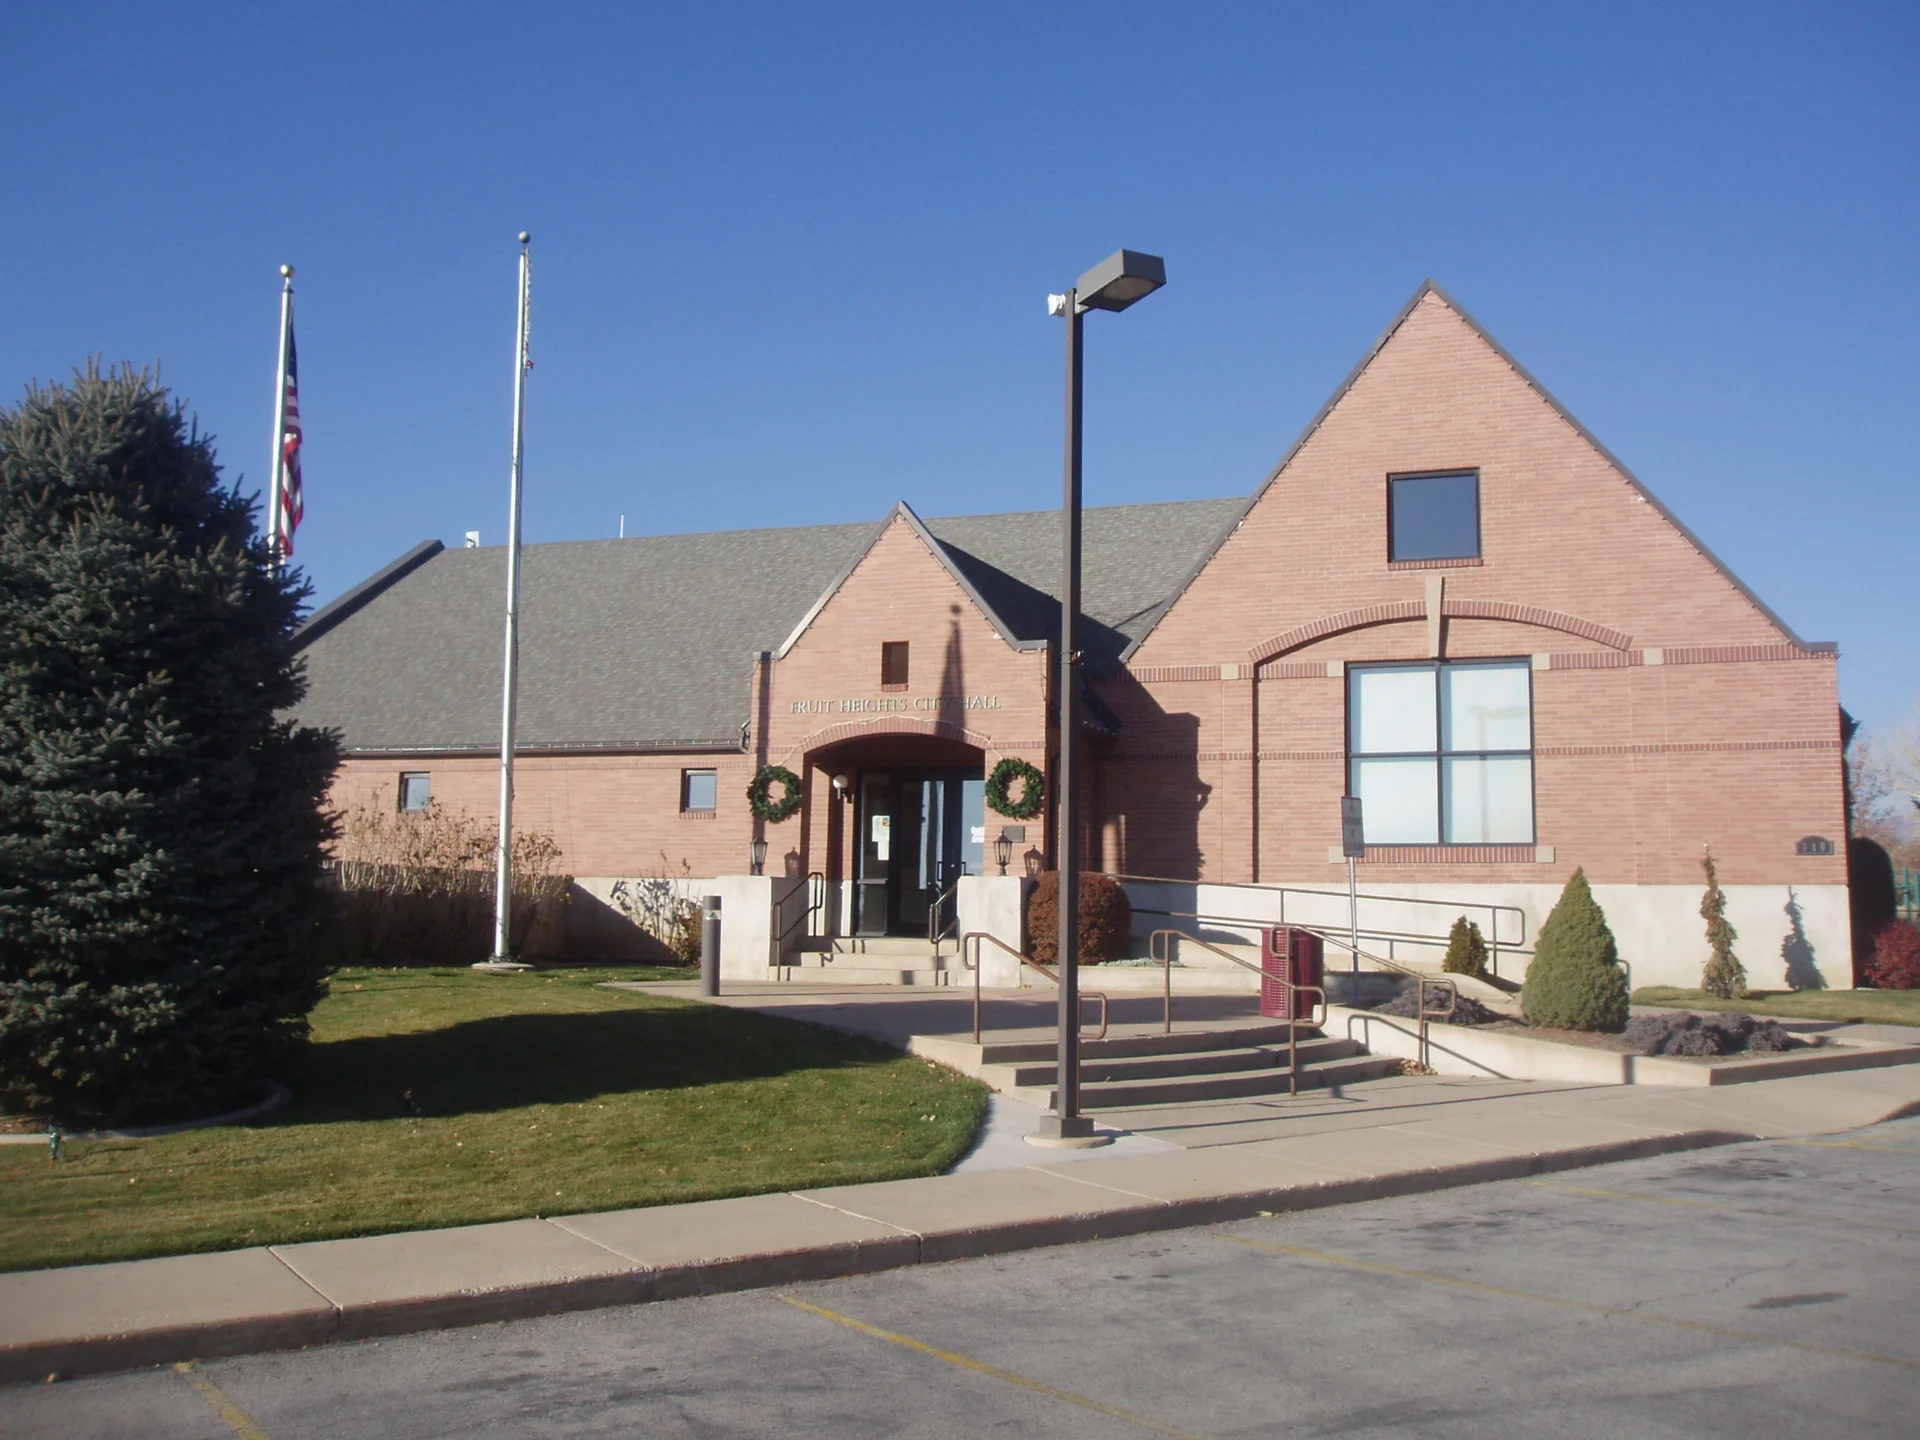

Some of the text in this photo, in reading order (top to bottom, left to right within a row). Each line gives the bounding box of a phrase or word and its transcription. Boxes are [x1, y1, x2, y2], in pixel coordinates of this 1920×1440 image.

[790, 695, 1001, 713] FRUIT HEIGHTS CITY HALL
